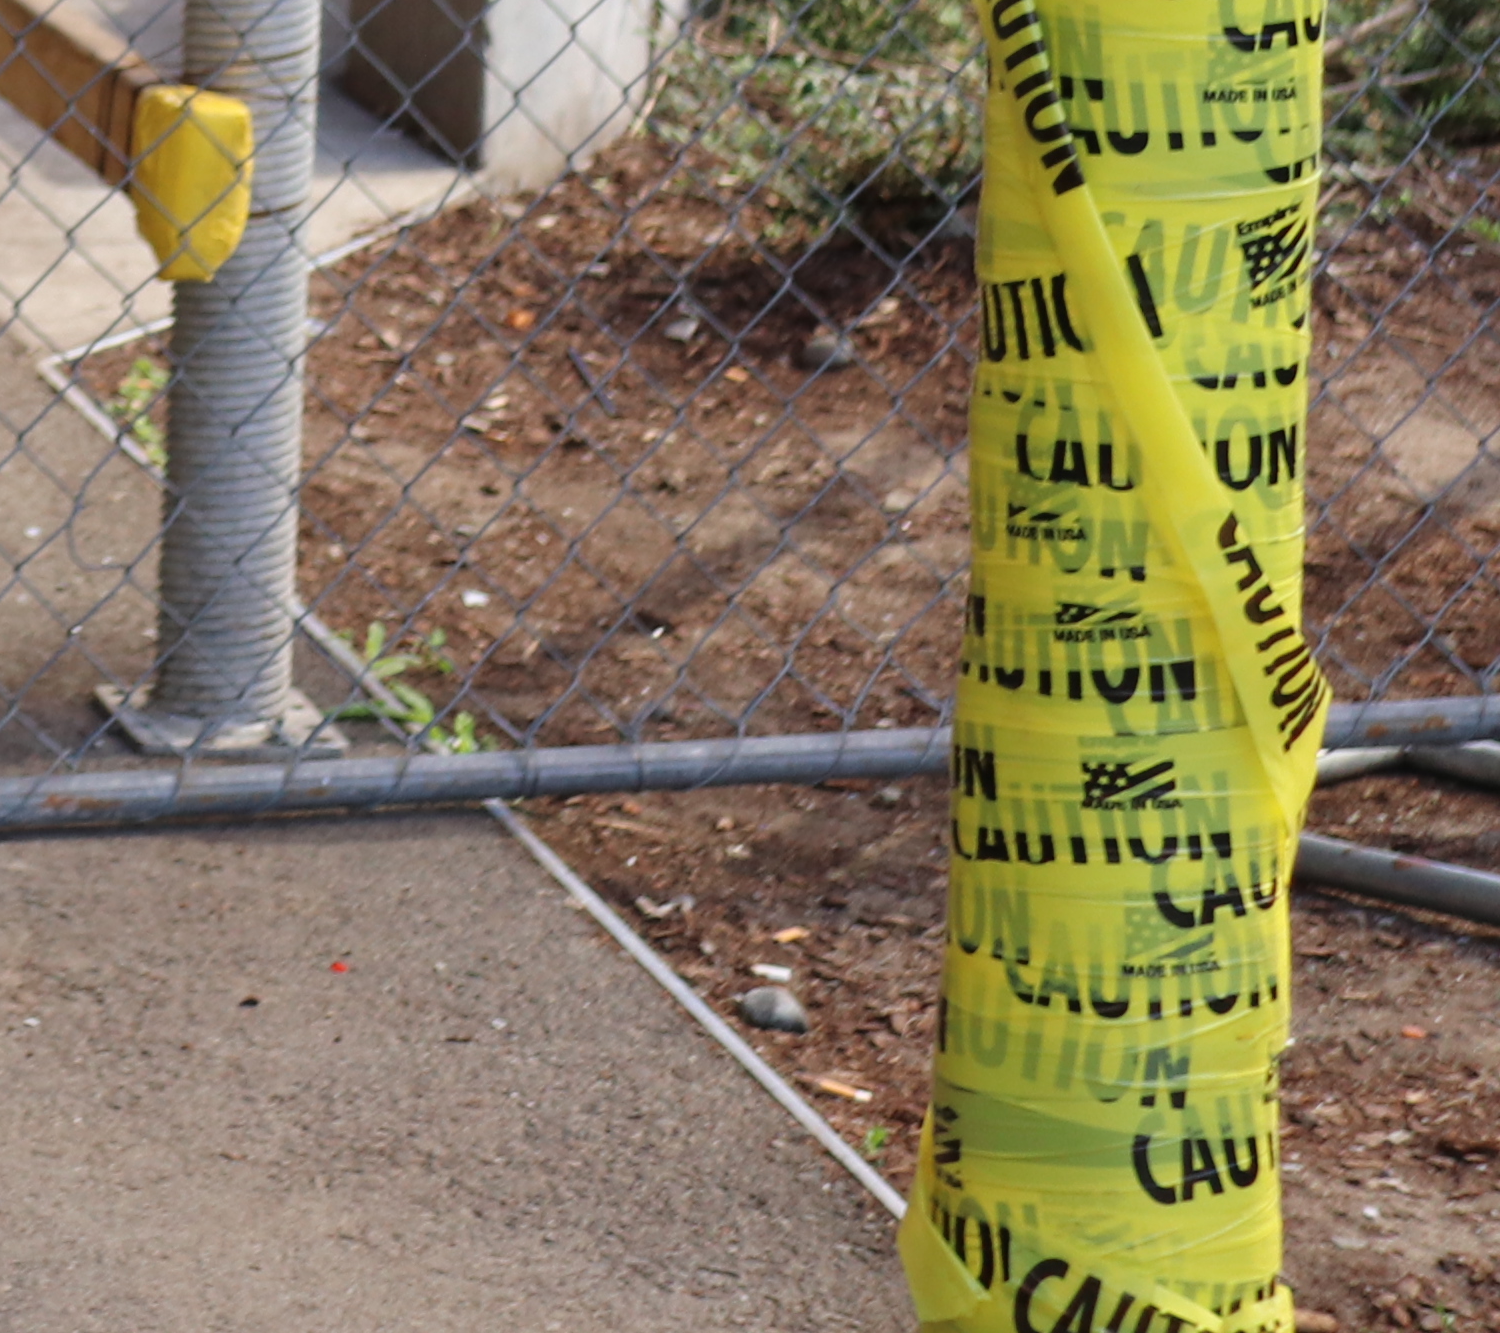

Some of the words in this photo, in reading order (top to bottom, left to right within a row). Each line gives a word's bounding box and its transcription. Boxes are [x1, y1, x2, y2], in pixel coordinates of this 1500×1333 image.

[1203, 87, 1248, 104] MADE
[1253, 87, 1268, 103] IN
[1272, 87, 1297, 102] USA
[1006, 524, 1044, 541] MADE
[1045, 526, 1058, 541] IN
[1060, 526, 1089, 542] USA
[1054, 627, 1098, 643] MADE
[1101, 625, 1117, 641] IN
[1121, 623, 1153, 639] USA
[1121, 959, 1166, 978] MADE
